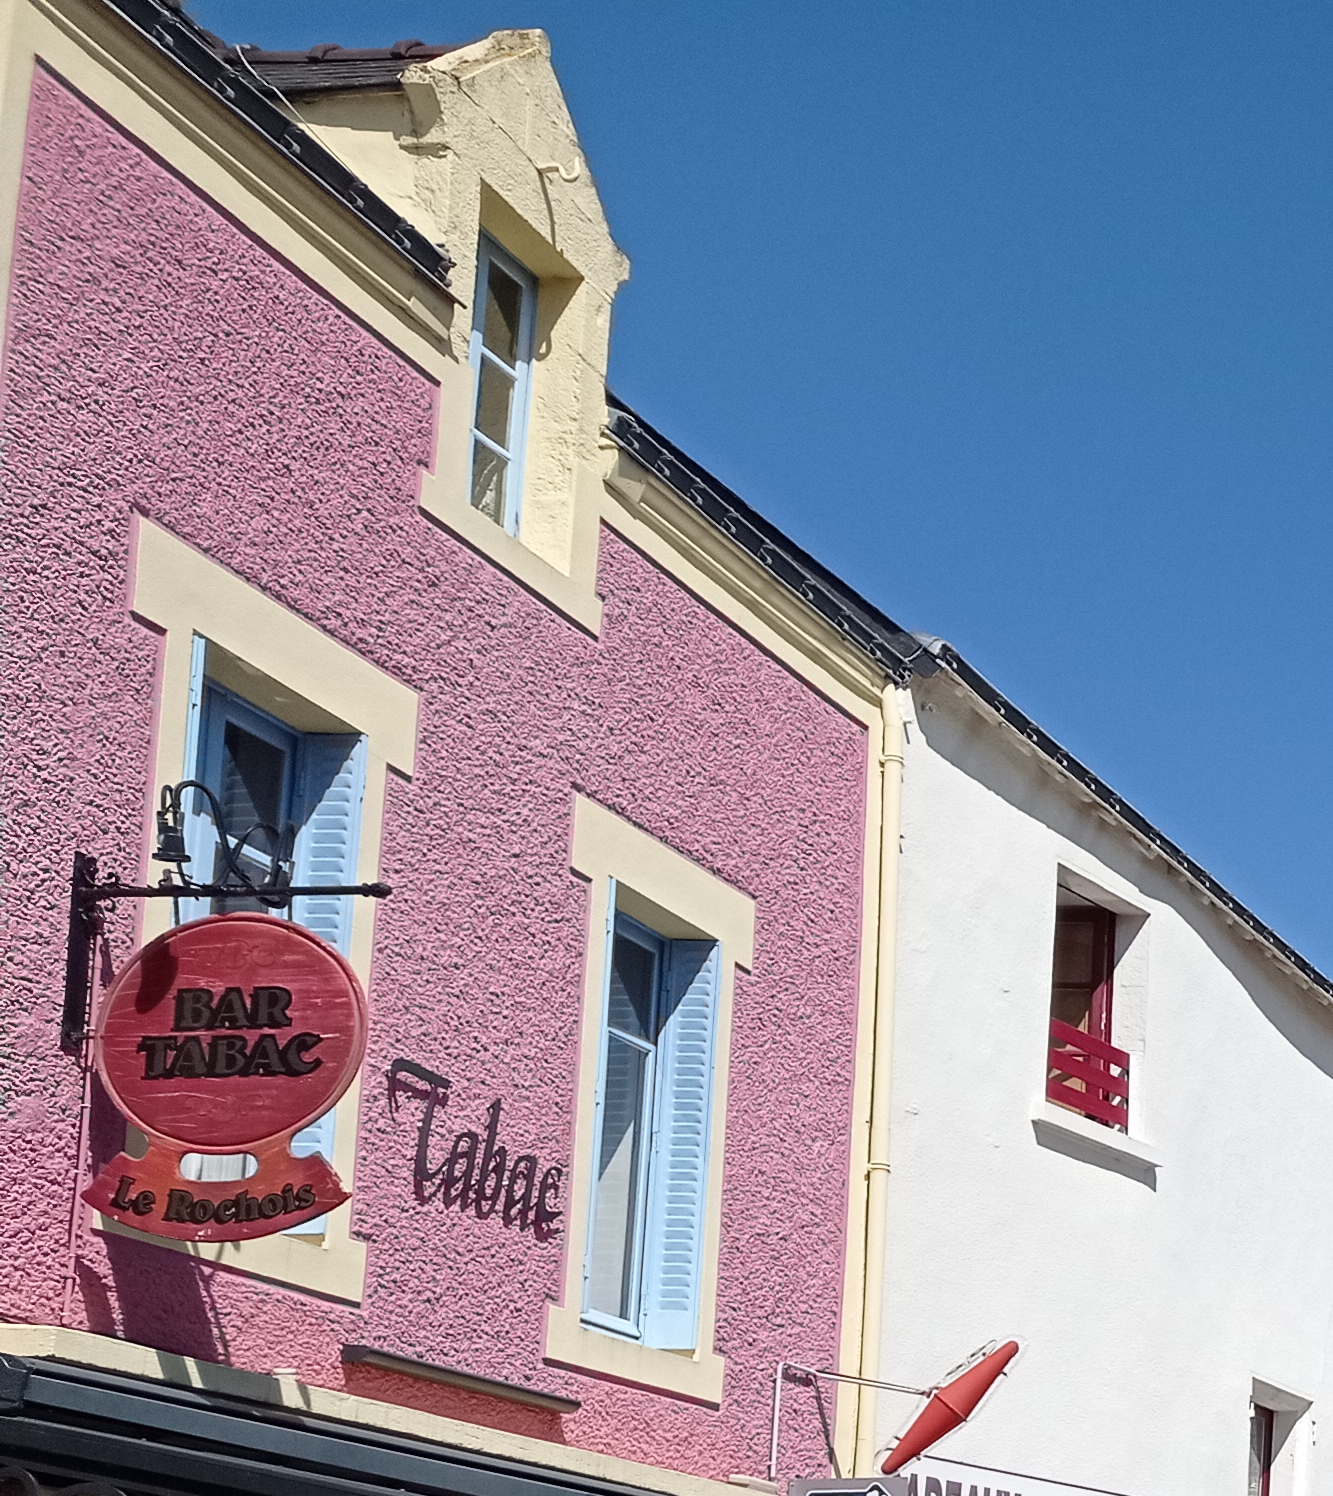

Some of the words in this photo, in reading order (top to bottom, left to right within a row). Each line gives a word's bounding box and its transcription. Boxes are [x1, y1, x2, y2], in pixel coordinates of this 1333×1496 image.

[172, 986, 293, 1032] BAR
[137, 1032, 324, 1080] TABAC
[387, 1057, 564, 1226] Tabac
[110, 1175, 155, 1215] Le
[162, 1183, 316, 1224] Rochois
